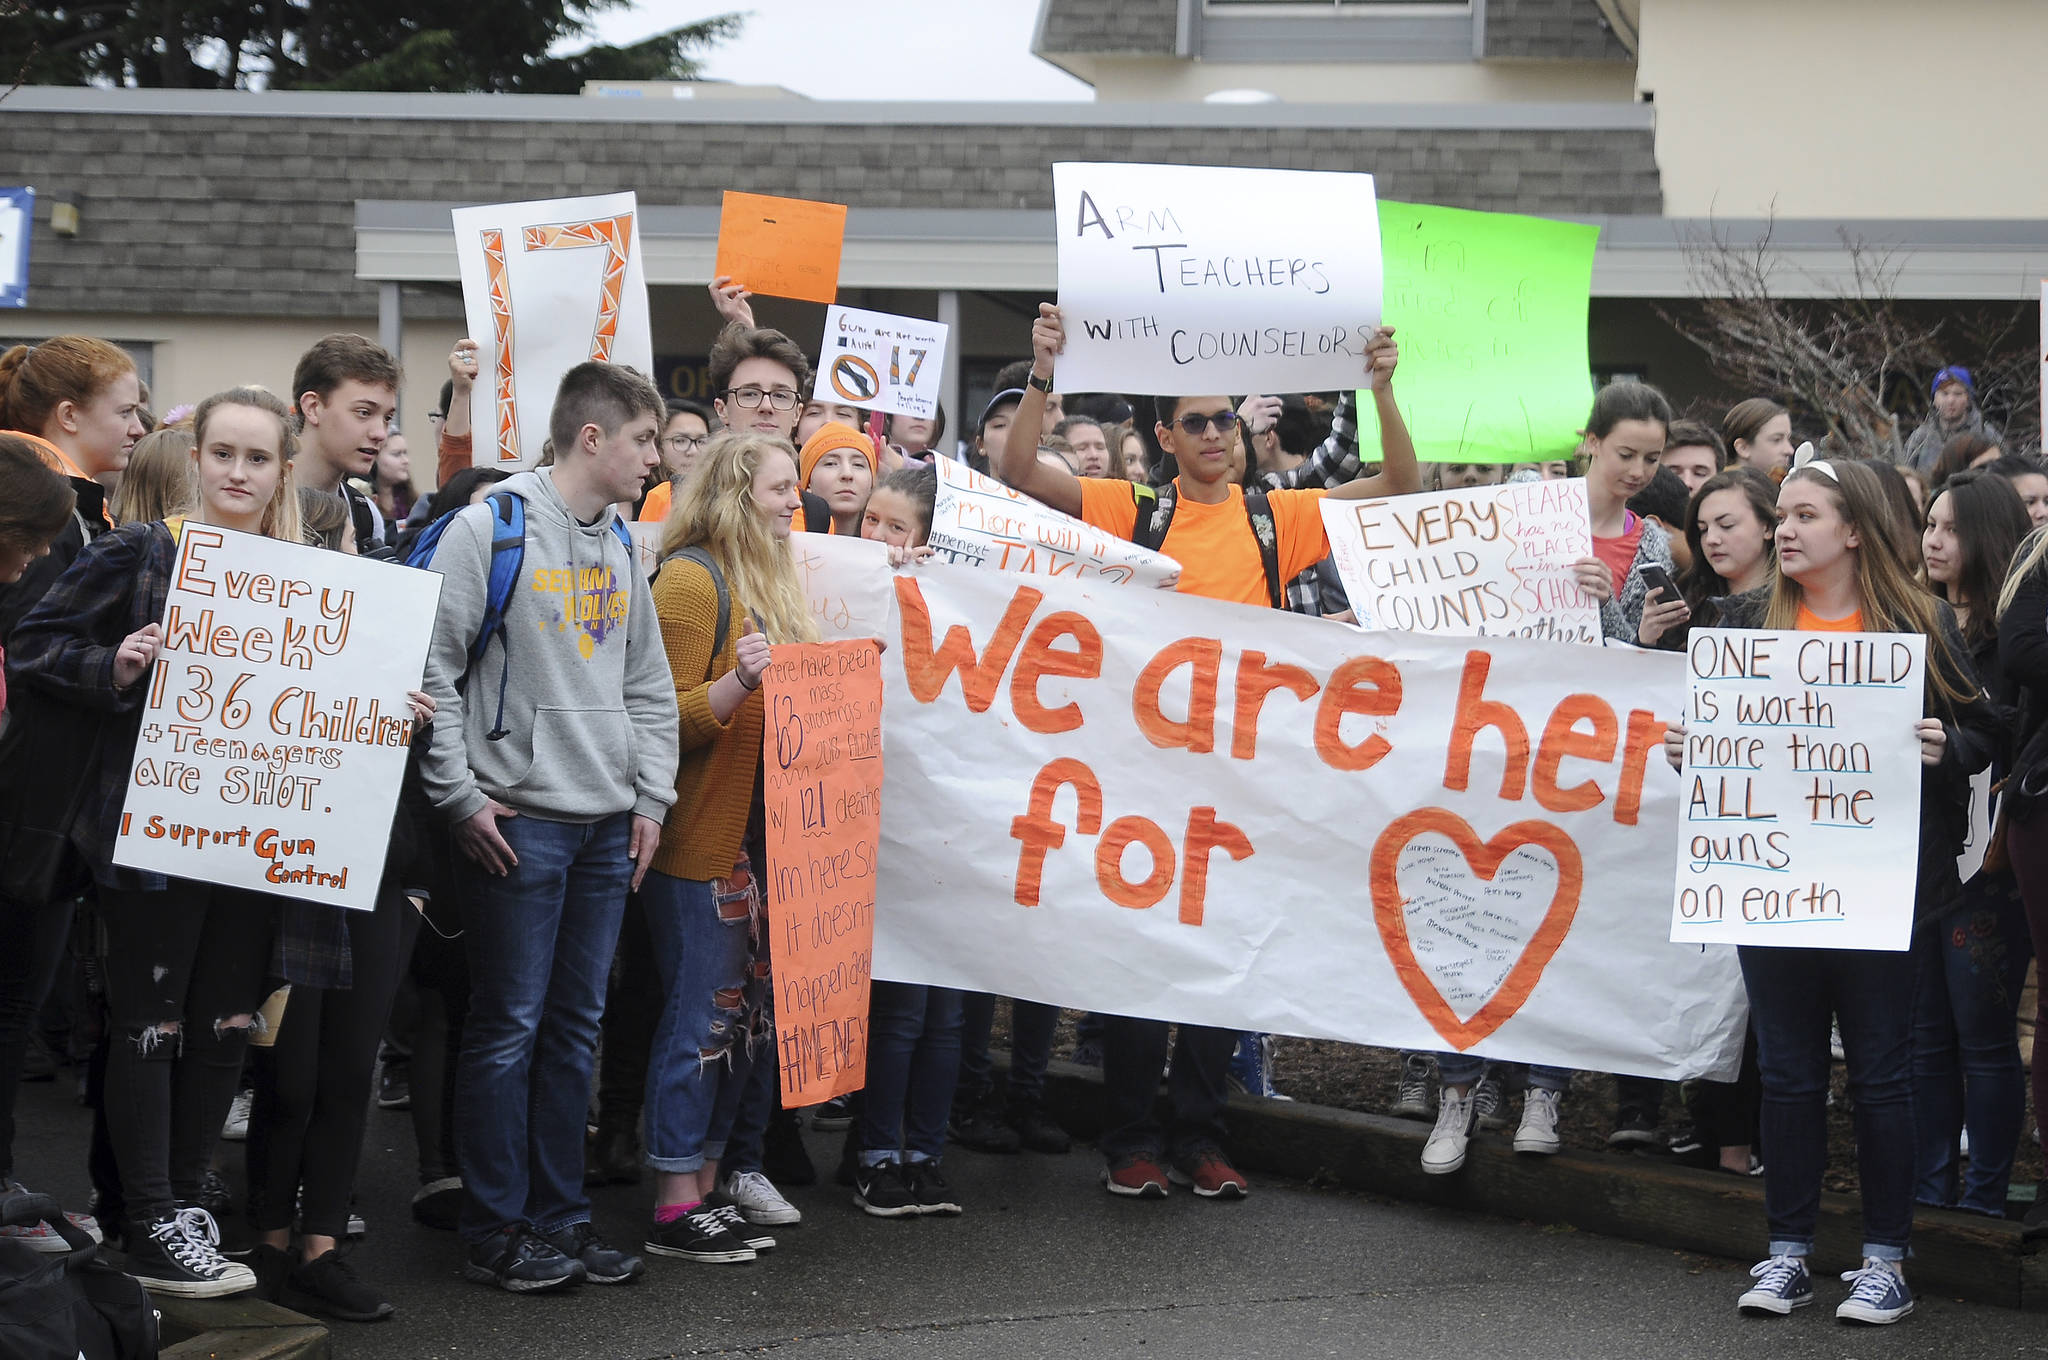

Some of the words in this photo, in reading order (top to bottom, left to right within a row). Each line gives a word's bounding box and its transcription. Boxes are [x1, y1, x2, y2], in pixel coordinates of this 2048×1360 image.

[1077, 190, 1183, 239] ARM
[1132, 244, 1330, 294] TEACHERS
[480, 212, 633, 462] 17
[1083, 316, 1159, 340] WITH
[1171, 326, 1374, 365] COUNSELORS
[889, 345, 927, 387] 17
[930, 530, 990, 555] #menext
[1038, 525, 1081, 551] will
[1355, 499, 1499, 550] EVERY
[1523, 537, 1577, 558] PLACE
[176, 529, 354, 655] Every
[1368, 551, 1479, 588] CHILD
[1376, 580, 1508, 632] COUNTS
[165, 605, 313, 670] Week
[1691, 636, 1778, 678] ONE
[1798, 639, 1912, 685] CHILD
[801, 650, 834, 679] have
[838, 648, 875, 676] been
[149, 660, 256, 730] 136
[270, 686, 414, 747] Children
[803, 701, 862, 735] shootings
[810, 682, 844, 705] mass
[1693, 685, 1718, 721] is
[1737, 691, 1835, 728] worth
[169, 725, 343, 775] Teenagers
[1131, 637, 1403, 771] are
[1442, 649, 1667, 826] her
[1690, 734, 1764, 769] more
[1787, 733, 1872, 772] than
[135, 757, 200, 794] are
[220, 766, 332, 813] SHOT.
[800, 780, 826, 830] 121
[1688, 775, 1778, 821] ALL
[1805, 777, 1874, 825] the
[120, 812, 130, 836] I
[144, 815, 250, 849] Support
[254, 829, 315, 859] Gun
[1009, 756, 1257, 927] for
[1690, 831, 1790, 873] guns
[265, 862, 347, 890] Control
[807, 848, 854, 896] here
[1680, 884, 1723, 919] on
[1742, 882, 1846, 922] earth.
[781, 961, 848, 1018] happen
